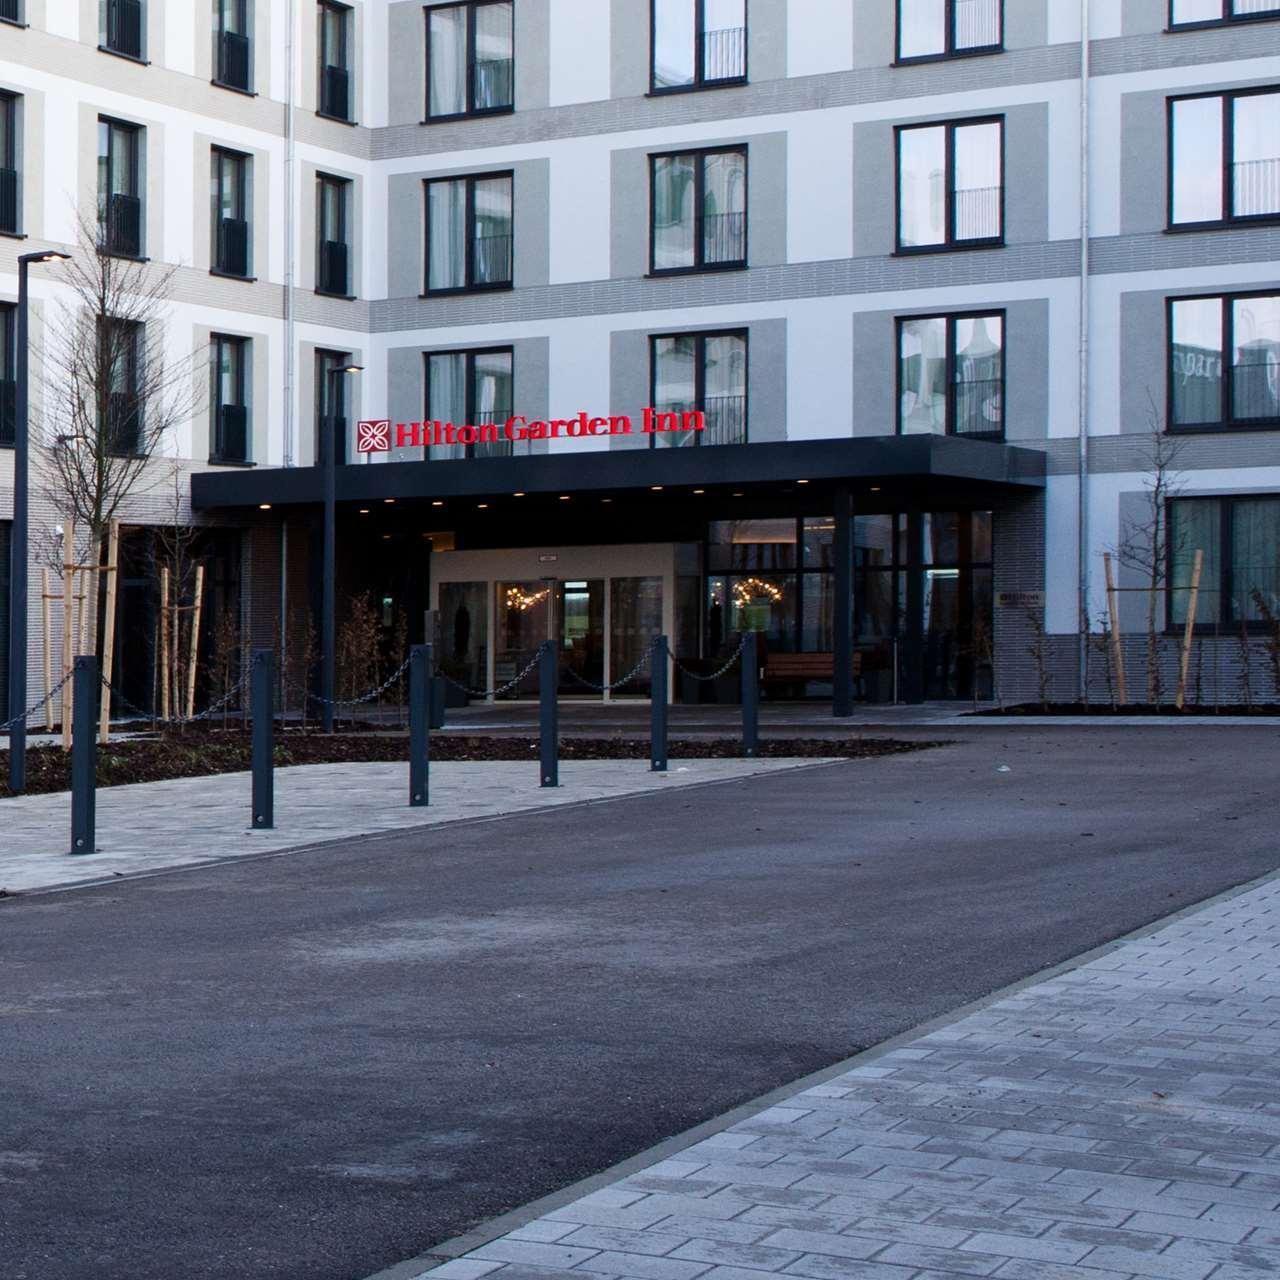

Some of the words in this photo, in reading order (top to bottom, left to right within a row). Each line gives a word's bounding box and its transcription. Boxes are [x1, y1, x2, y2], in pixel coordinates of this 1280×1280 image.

[395, 420, 499, 448] Hilton
[504, 411, 633, 442] Garden
[640, 406, 705, 433] Inn
